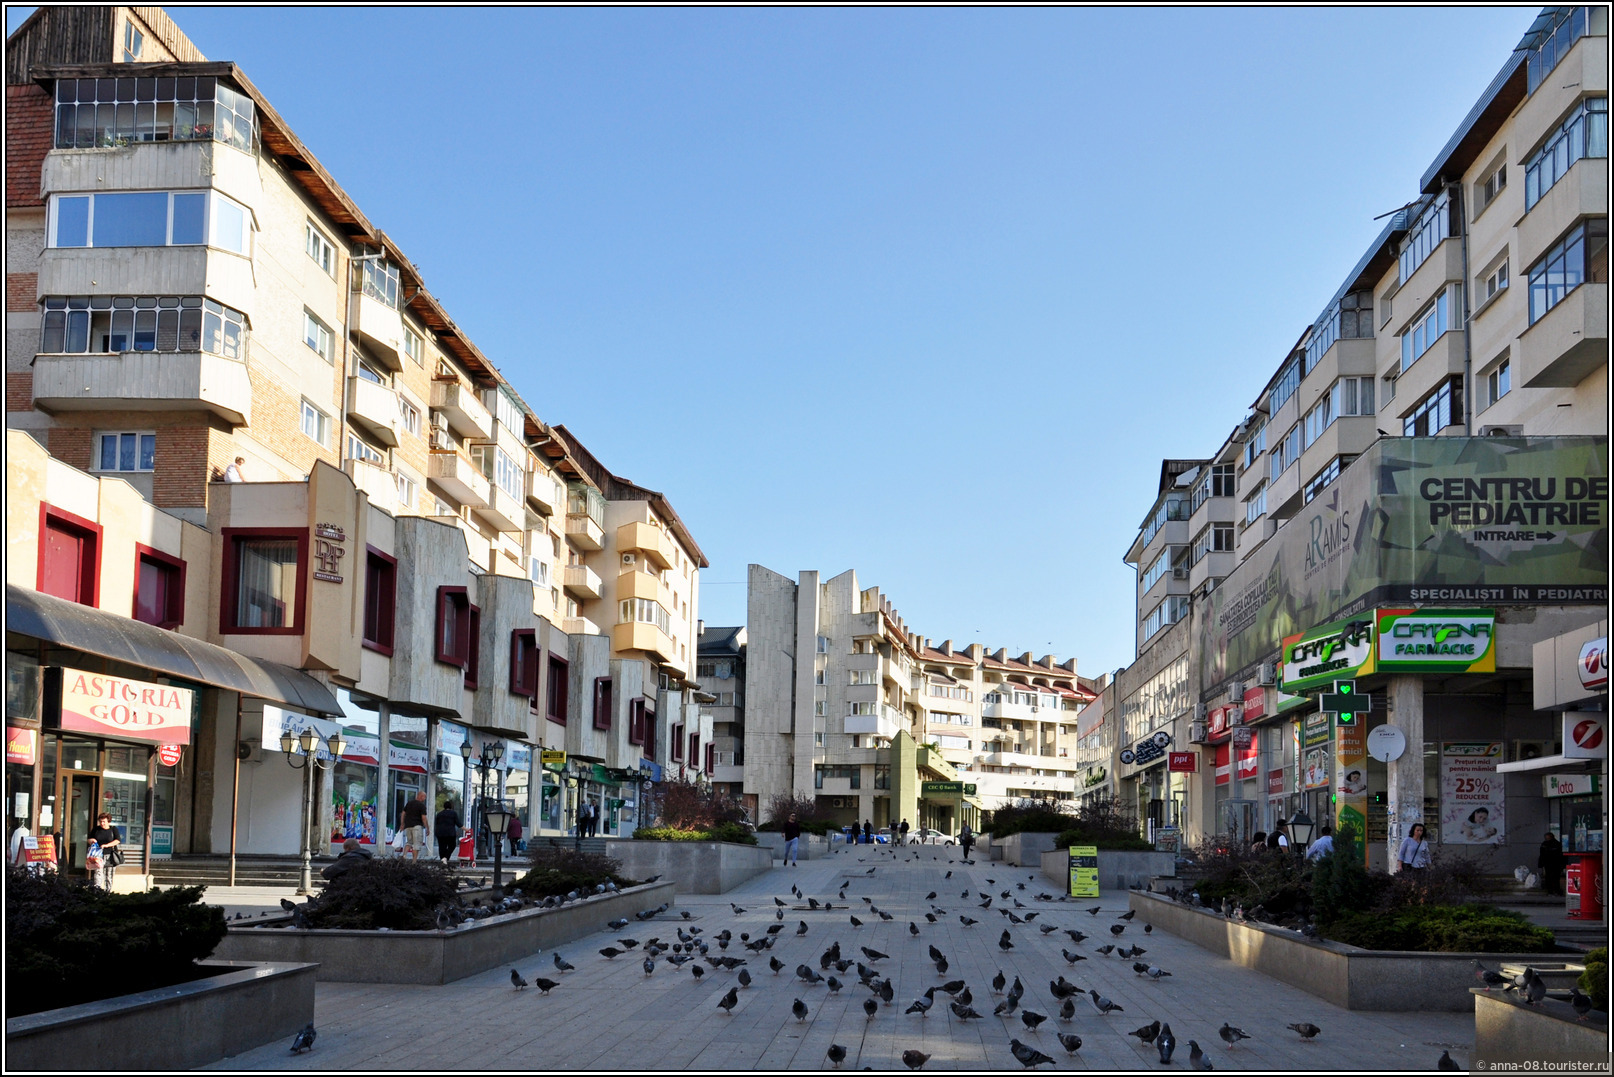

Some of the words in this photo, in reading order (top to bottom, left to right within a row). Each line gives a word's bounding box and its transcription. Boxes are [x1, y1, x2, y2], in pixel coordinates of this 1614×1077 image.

[1420, 477, 1556, 501] CENTRU
[1565, 477, 1608, 501] DE
[1430, 502, 1600, 525] PEDIATRIE
[1304, 510, 1350, 572] ARAMIS
[1474, 531, 1535, 541] INTRARE
[1512, 586, 1529, 599] ÎN
[1393, 623, 1491, 638] CATENA
[1395, 643, 1475, 655] FARMACIE
[1299, 657, 1349, 678] FARMACIE
[70, 675, 182, 710] ASTORIA
[89, 704, 165, 725] GOLD
[8, 740, 31, 754] Hand
[1174, 755, 1188, 763] ppt
[1455, 777, 1490, 793] 25%
[1557, 781, 1574, 794] loto
